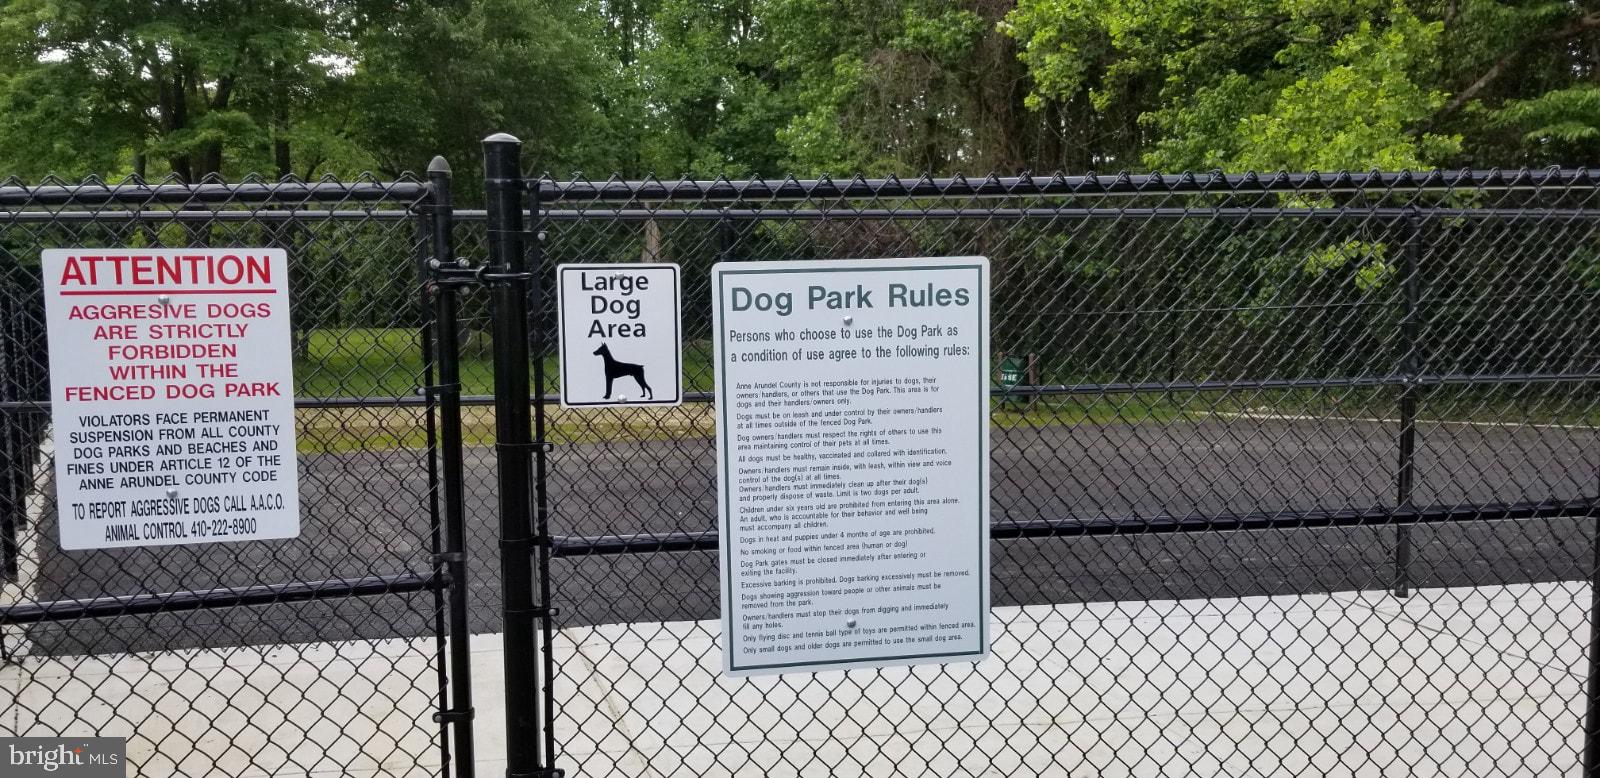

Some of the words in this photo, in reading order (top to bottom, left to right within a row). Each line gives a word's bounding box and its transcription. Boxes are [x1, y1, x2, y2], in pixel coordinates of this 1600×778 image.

[60, 255, 271, 286] ATTENTION
[581, 272, 649, 296] Large
[591, 295, 640, 319] Dog
[731, 287, 793, 317] Dog
[808, 284, 873, 310] Park
[888, 282, 970, 307] Rules
[68, 303, 196, 321] AGGRESIVE
[208, 302, 270, 318] DOGS
[93, 324, 137, 340] ARE
[149, 322, 248, 339] STRICTLY
[588, 319, 647, 338] Area
[730, 328, 770, 342] Persons
[775, 328, 794, 340] who
[799, 327, 836, 340] choose
[840, 326, 851, 340] to
[855, 329, 872, 338] use
[878, 326, 892, 337] the
[897, 325, 916, 340] Dog
[921, 324, 942, 336] Park
[947, 326, 957, 335] as
[108, 342, 237, 360] FORBIDDEN
[731, 353, 736, 362] a
[741, 348, 787, 362] condition
[792, 348, 801, 360] of
[807, 350, 824, 359] use
[829, 349, 856, 361] agree
[862, 347, 871, 358] to
[876, 345, 891, 357] the
[896, 344, 939, 360] following
[944, 343, 969, 355] rules:
[109, 364, 187, 380] WITHIN
[195, 362, 238, 378] THE
[65, 384, 155, 402] FENCED
[166, 383, 214, 399] DOG
[225, 381, 280, 397] PARK
[78, 413, 150, 427] VIOLATORS
[155, 411, 188, 425] FACE
[193, 409, 270, 424] PERMANENT
[69, 428, 153, 444] SUSPENSION
[158, 427, 195, 440] FROM
[200, 426, 223, 439] ALL
[228, 424, 280, 438] COUNTY
[74, 445, 102, 459] DOG
[108, 444, 149, 458] PARKS
[156, 443, 181, 456] AND
[188, 440, 246, 455] BEACHES
[252, 439, 277, 452] AND
[67, 461, 104, 475] FINES
[110, 459, 154, 473] UNDER
[159, 457, 212, 471] ARTICLE
[217, 456, 230, 469] 12
[235, 455, 252, 468] OF
[257, 454, 280, 467] THE
[78, 476, 114, 490] ANNE
[119, 474, 180, 488] ARUNDEL
[184, 471, 237, 486] COUNTY
[242, 470, 277, 483] CODE
[72, 502, 85, 520] TO
[89, 500, 127, 519] REPORT
[130, 497, 189, 517] AGGRESSIVE
[193, 496, 220, 515] DOGS
[223, 495, 247, 513] CALL
[250, 493, 284, 512] A.A.C.O.
[104, 523, 140, 542] ANIMAL
[143, 520, 187, 540] CONTROL
[190, 517, 257, 537] 410-222-8900
